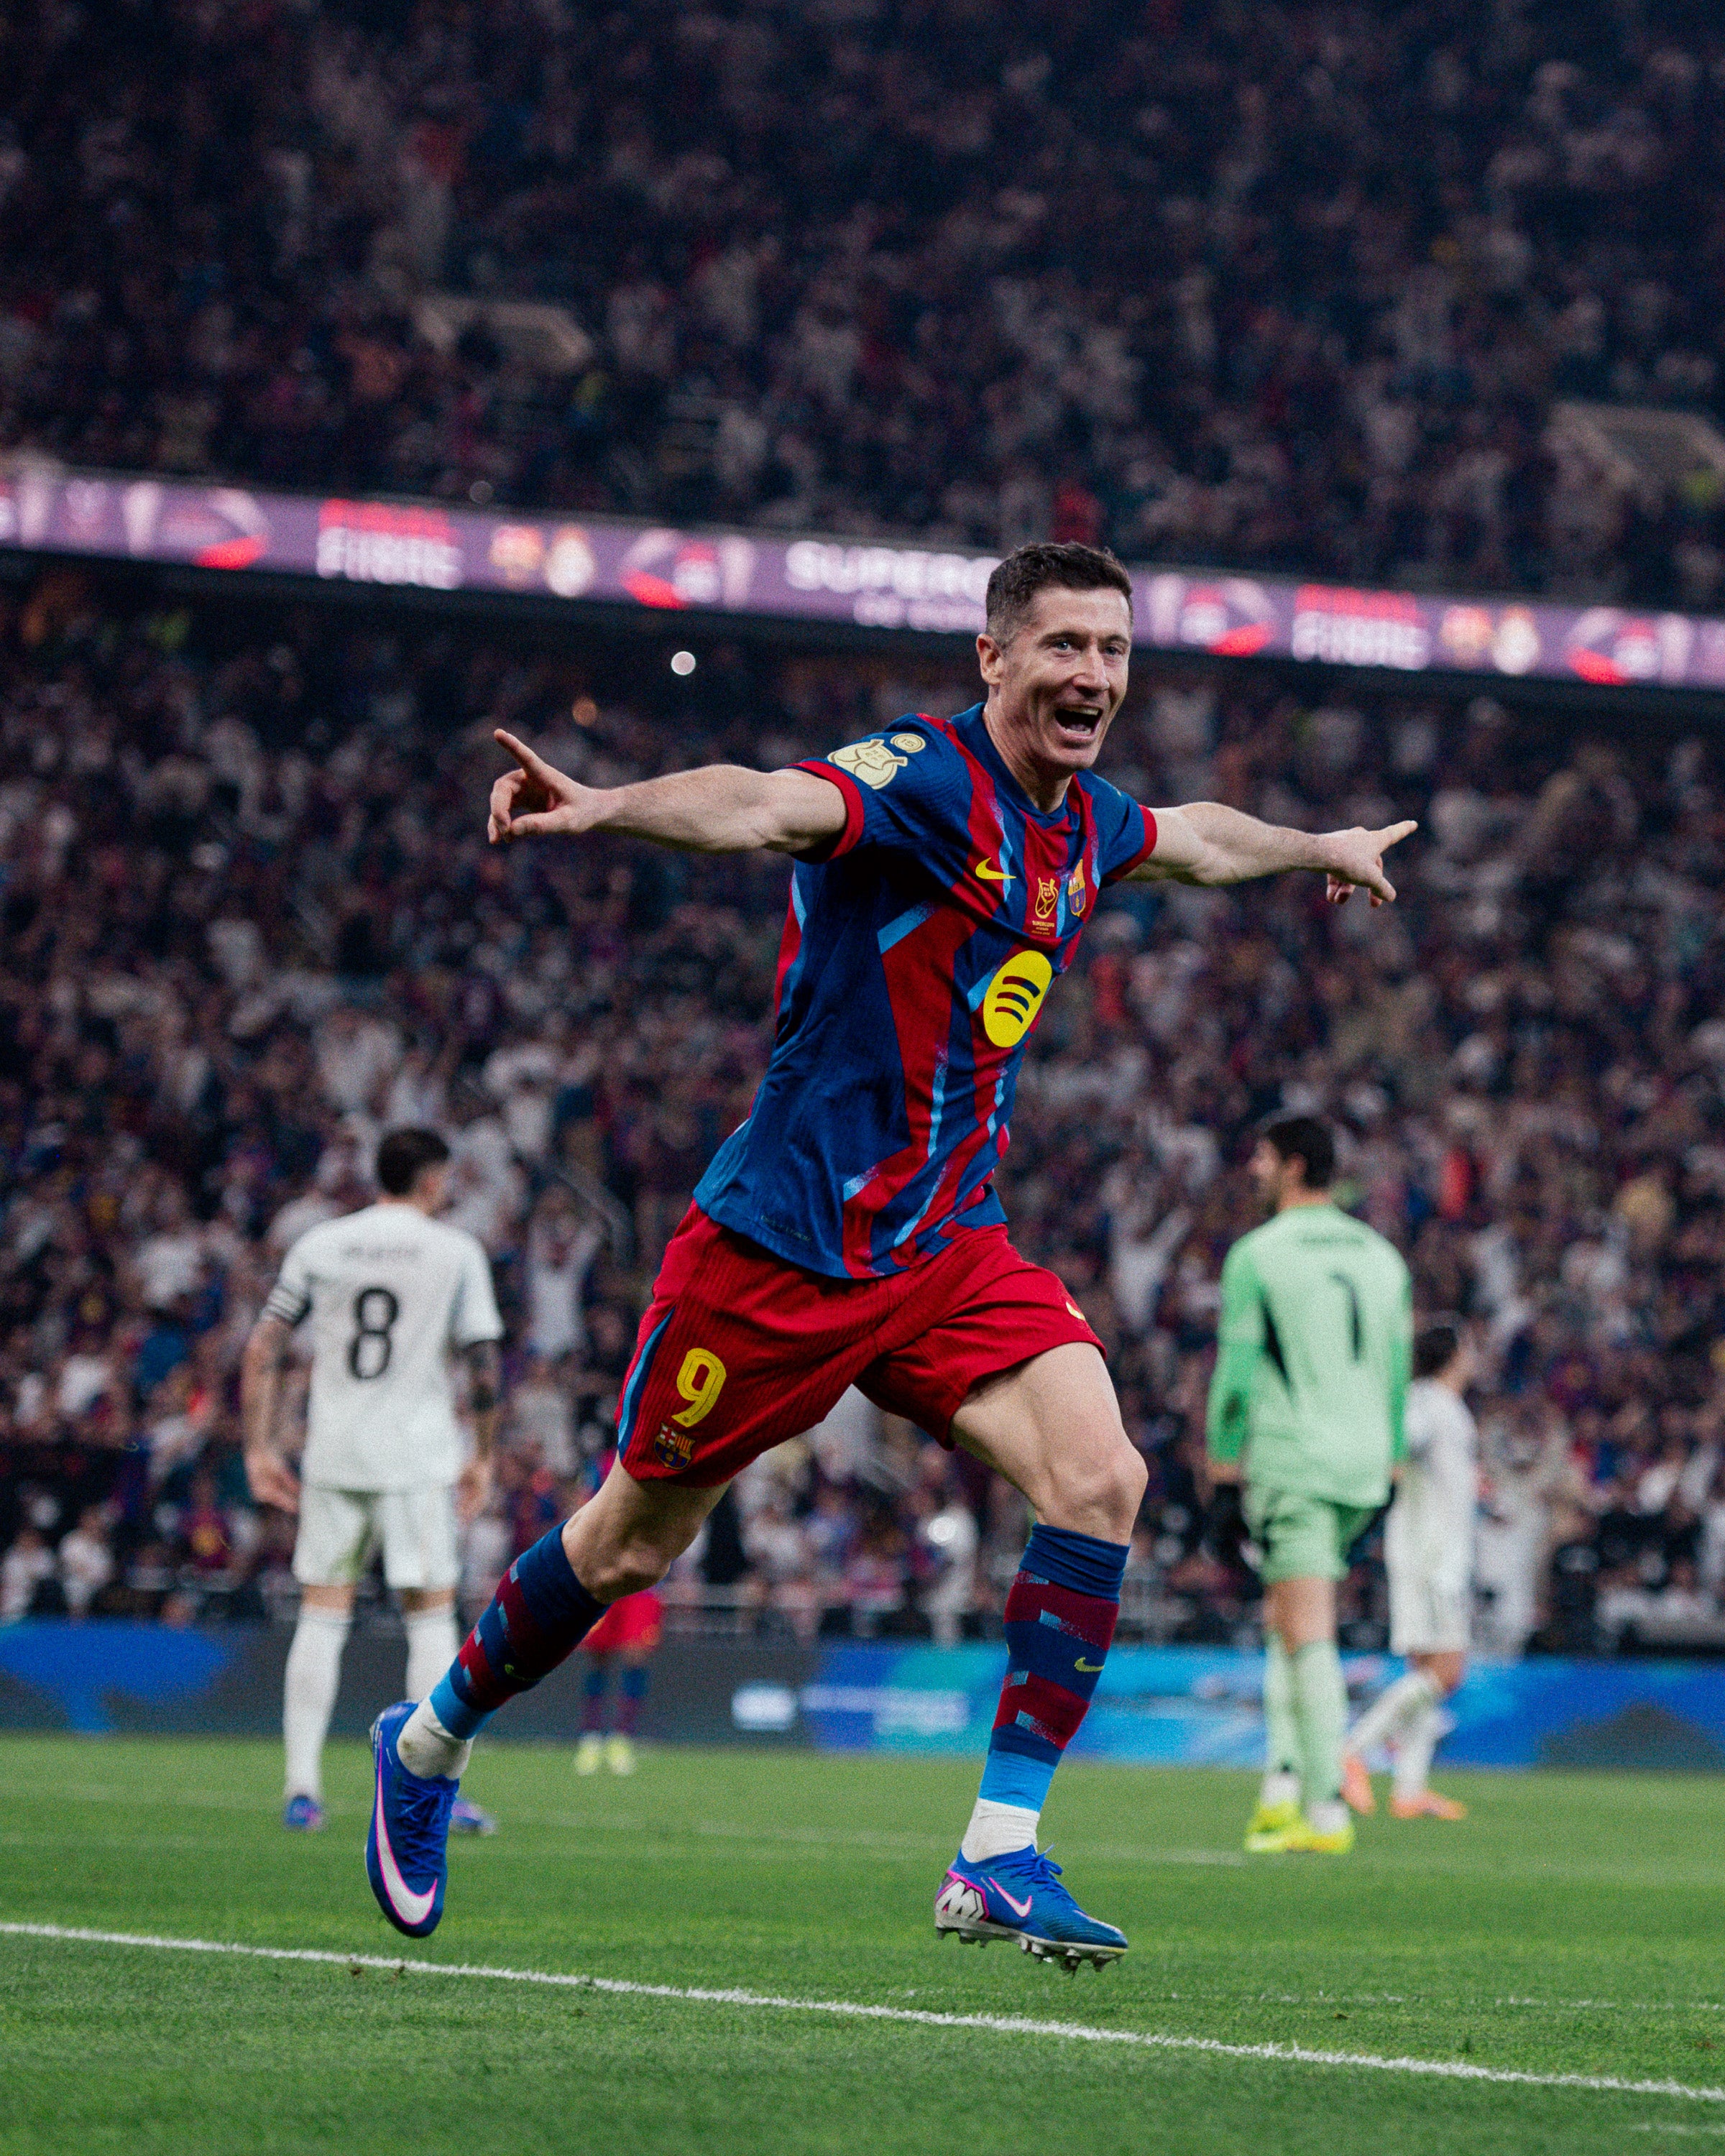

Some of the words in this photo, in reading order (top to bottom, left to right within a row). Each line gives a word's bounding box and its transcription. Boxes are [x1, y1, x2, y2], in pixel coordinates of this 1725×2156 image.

[349, 1285, 400, 1380] 8
[1329, 1271, 1361, 1362] 1
[671, 1348, 727, 1427] 9
